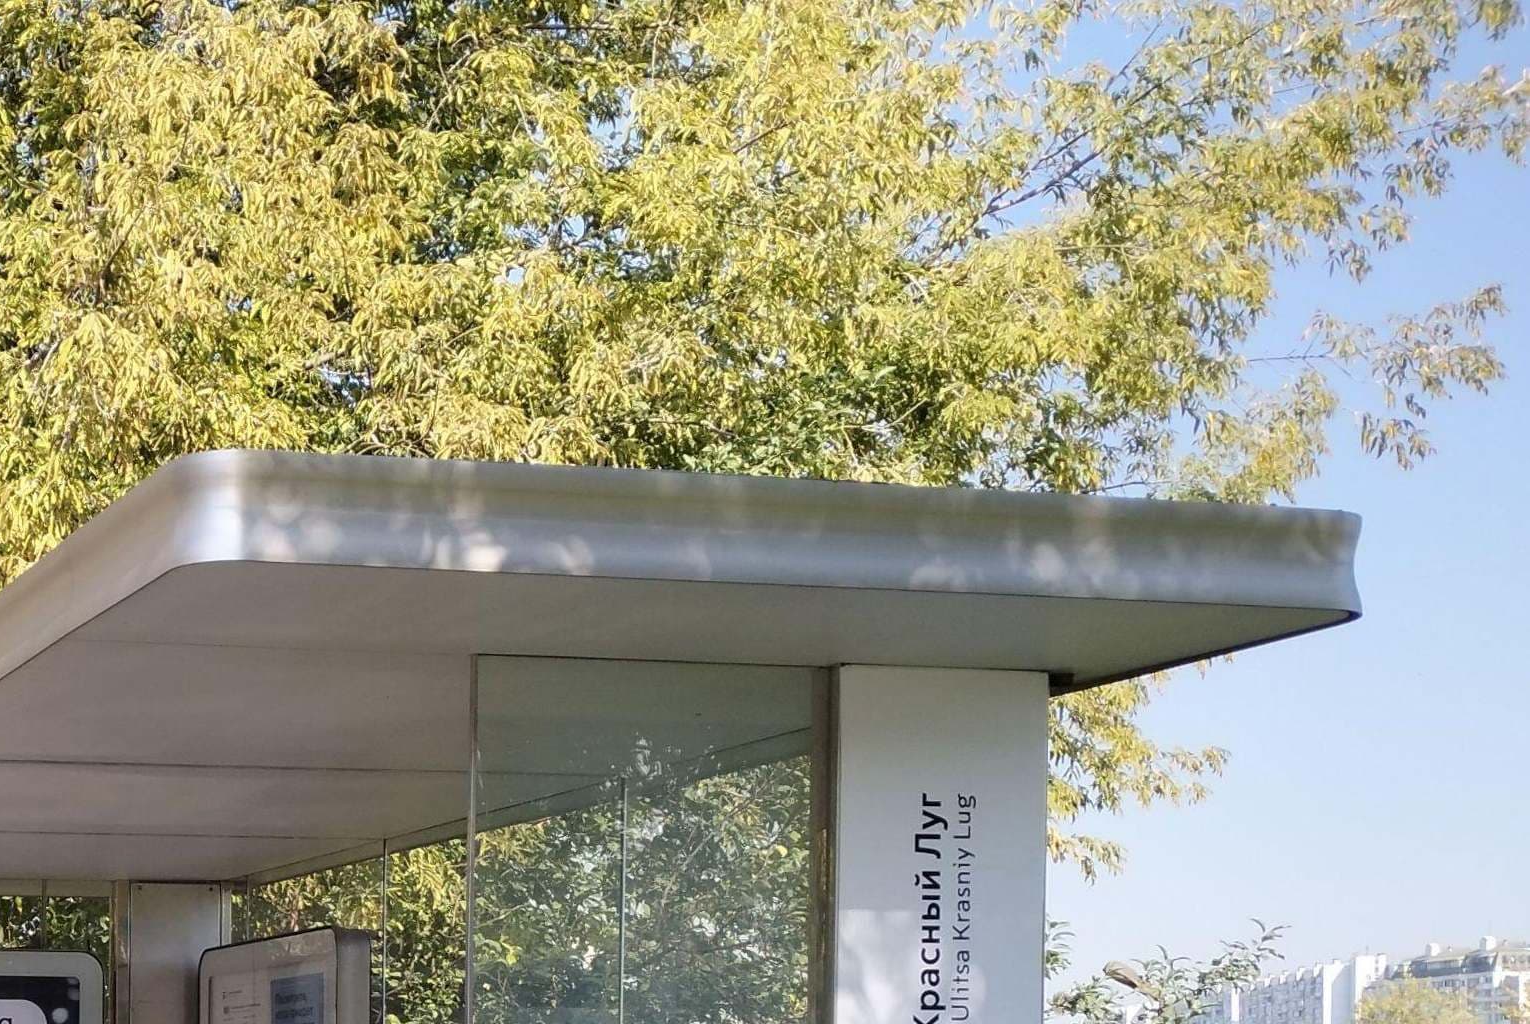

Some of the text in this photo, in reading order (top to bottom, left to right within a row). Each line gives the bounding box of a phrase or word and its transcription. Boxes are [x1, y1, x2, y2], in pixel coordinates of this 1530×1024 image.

[914, 793, 948, 860] Луг
[950, 793, 977, 1022] Ulitsa Krasniy Lug
